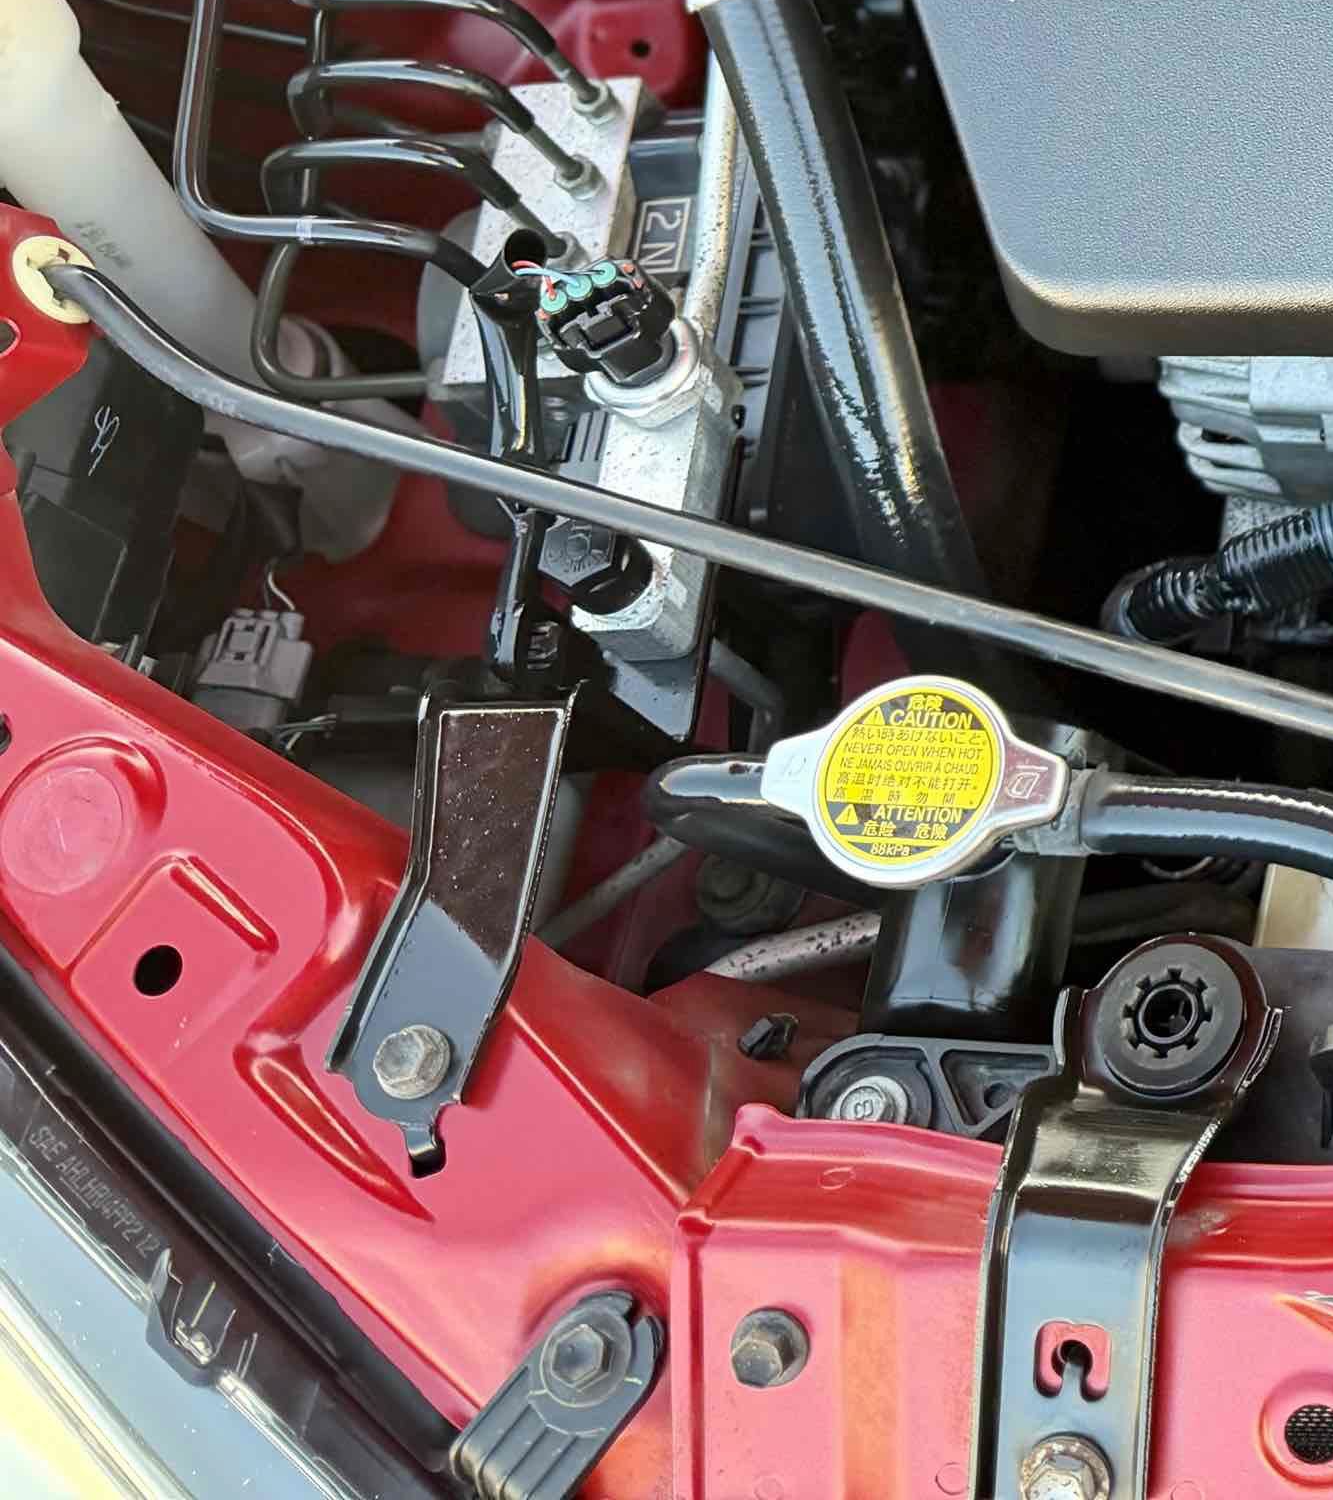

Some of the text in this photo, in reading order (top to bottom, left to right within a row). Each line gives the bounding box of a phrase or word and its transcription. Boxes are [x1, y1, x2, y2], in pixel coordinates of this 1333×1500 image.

[889, 708, 973, 729] CAUTION
[844, 742, 884, 756] NEVER
[886, 744, 917, 758] OPEN
[921, 746, 955, 760] WHEN
[840, 756, 855, 769] NE
[856, 758, 892, 771] JAMAIS
[893, 760, 933, 773] OUVRIR
[872, 804, 964, 824] ATTENTION
[870, 843, 912, 857] 88kPa
[28, 1126, 68, 1162] SAE
